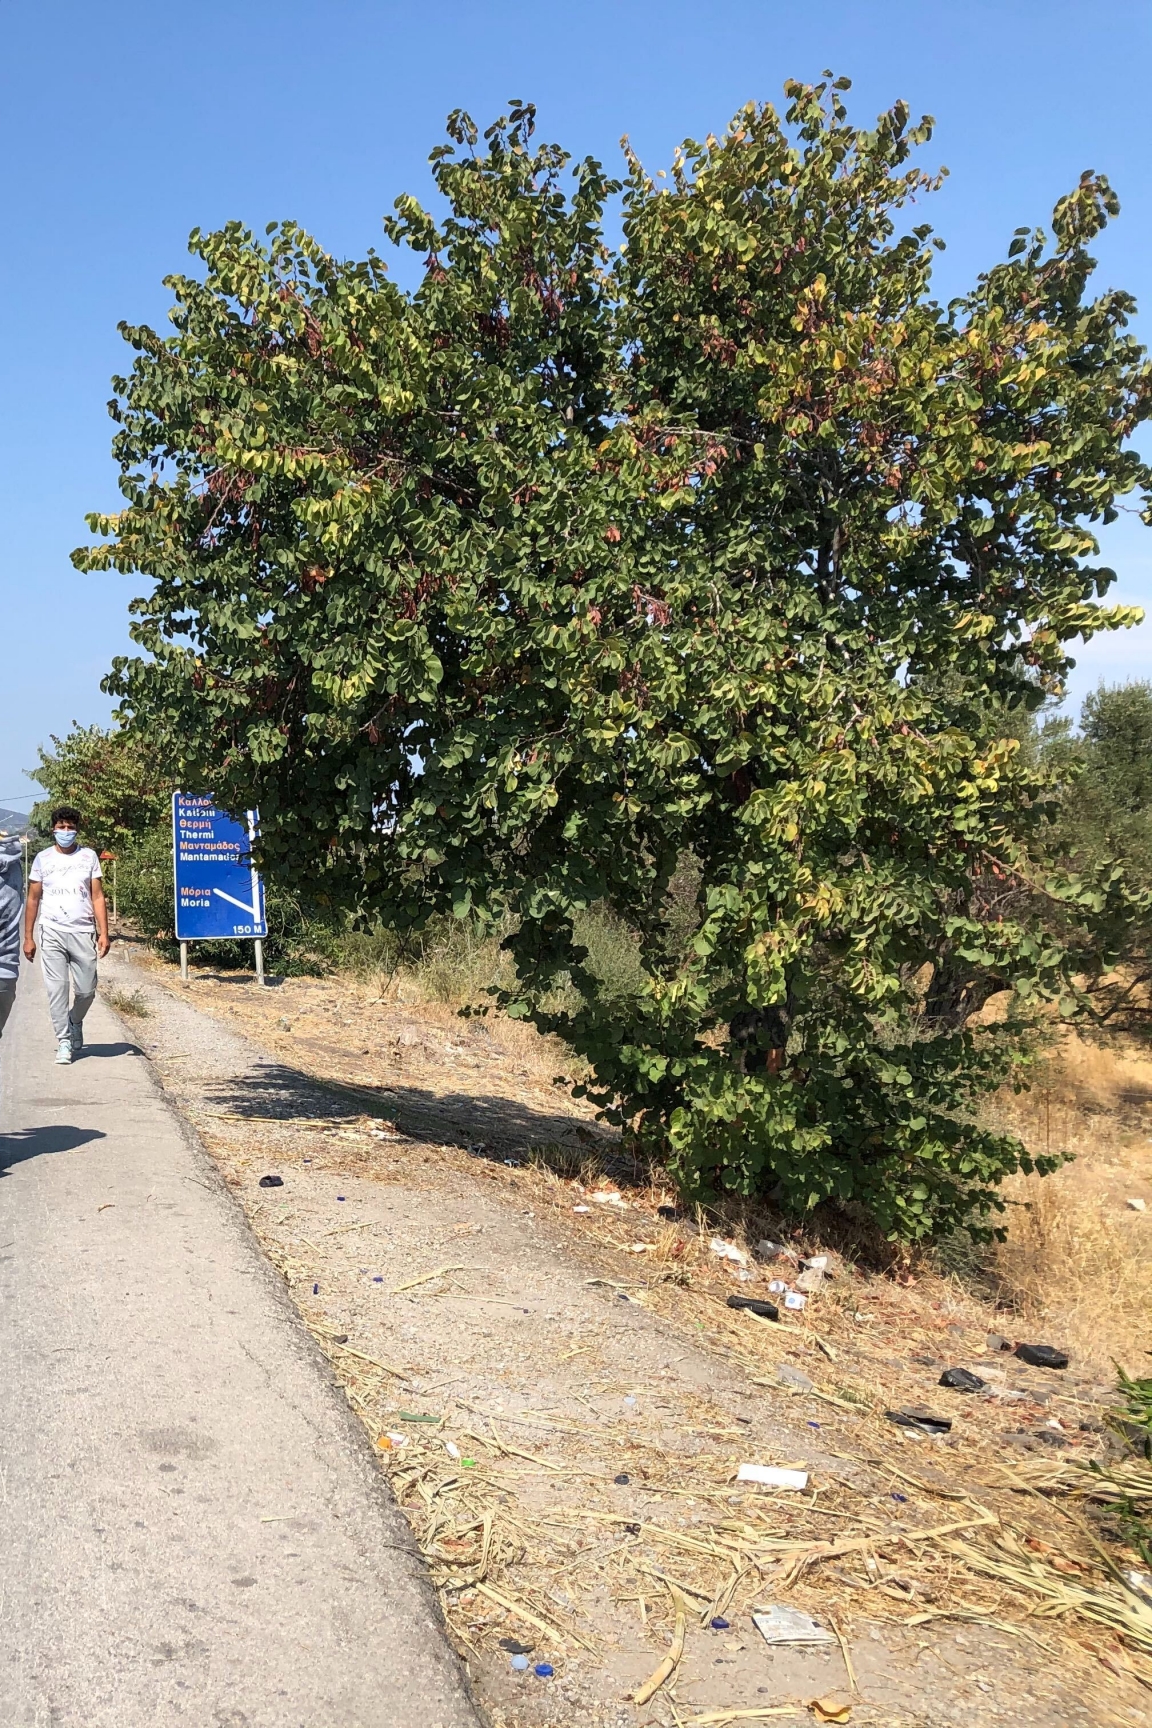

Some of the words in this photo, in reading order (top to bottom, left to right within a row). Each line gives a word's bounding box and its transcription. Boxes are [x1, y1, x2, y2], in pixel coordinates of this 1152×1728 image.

[179, 819, 212, 830] Θερμή
[179, 830, 215, 839] Thermi
[179, 841, 241, 852] Μανταμάδος
[180, 886, 211, 898] Μόρια
[180, 897, 211, 907] Moria
[232, 925, 252, 935] 150
[253, 925, 263, 934] M
